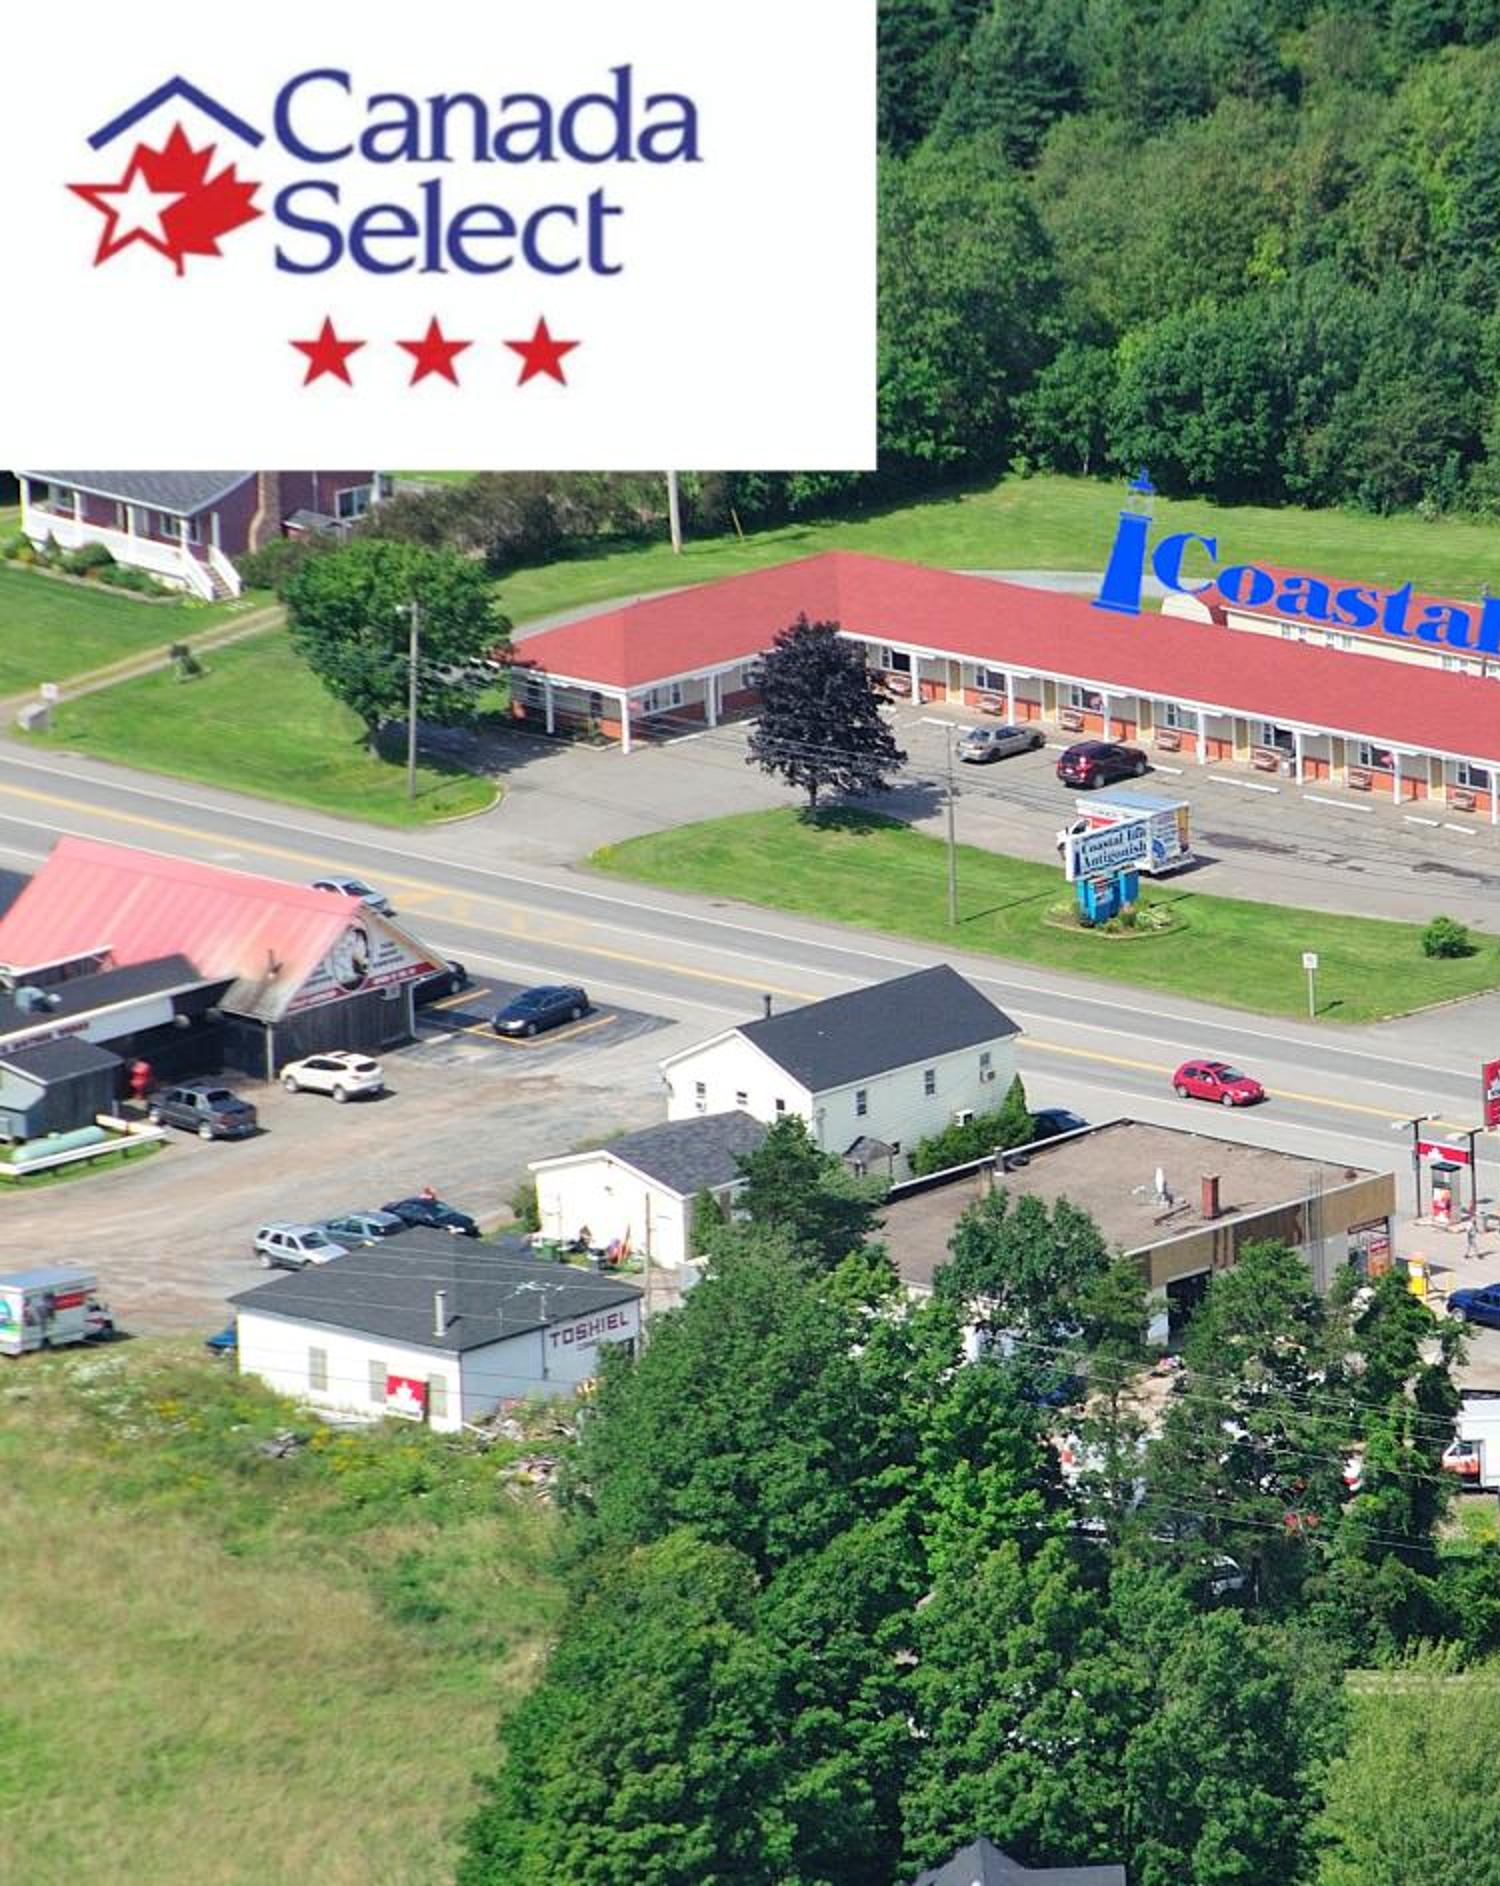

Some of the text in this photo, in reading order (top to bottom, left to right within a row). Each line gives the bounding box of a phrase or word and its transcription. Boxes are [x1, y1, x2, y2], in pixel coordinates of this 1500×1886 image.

[1081, 831, 1124, 854] Coastal
[1083, 840, 1147, 869] Antigonish
[549, 1311, 629, 1349] TOSHIEL
